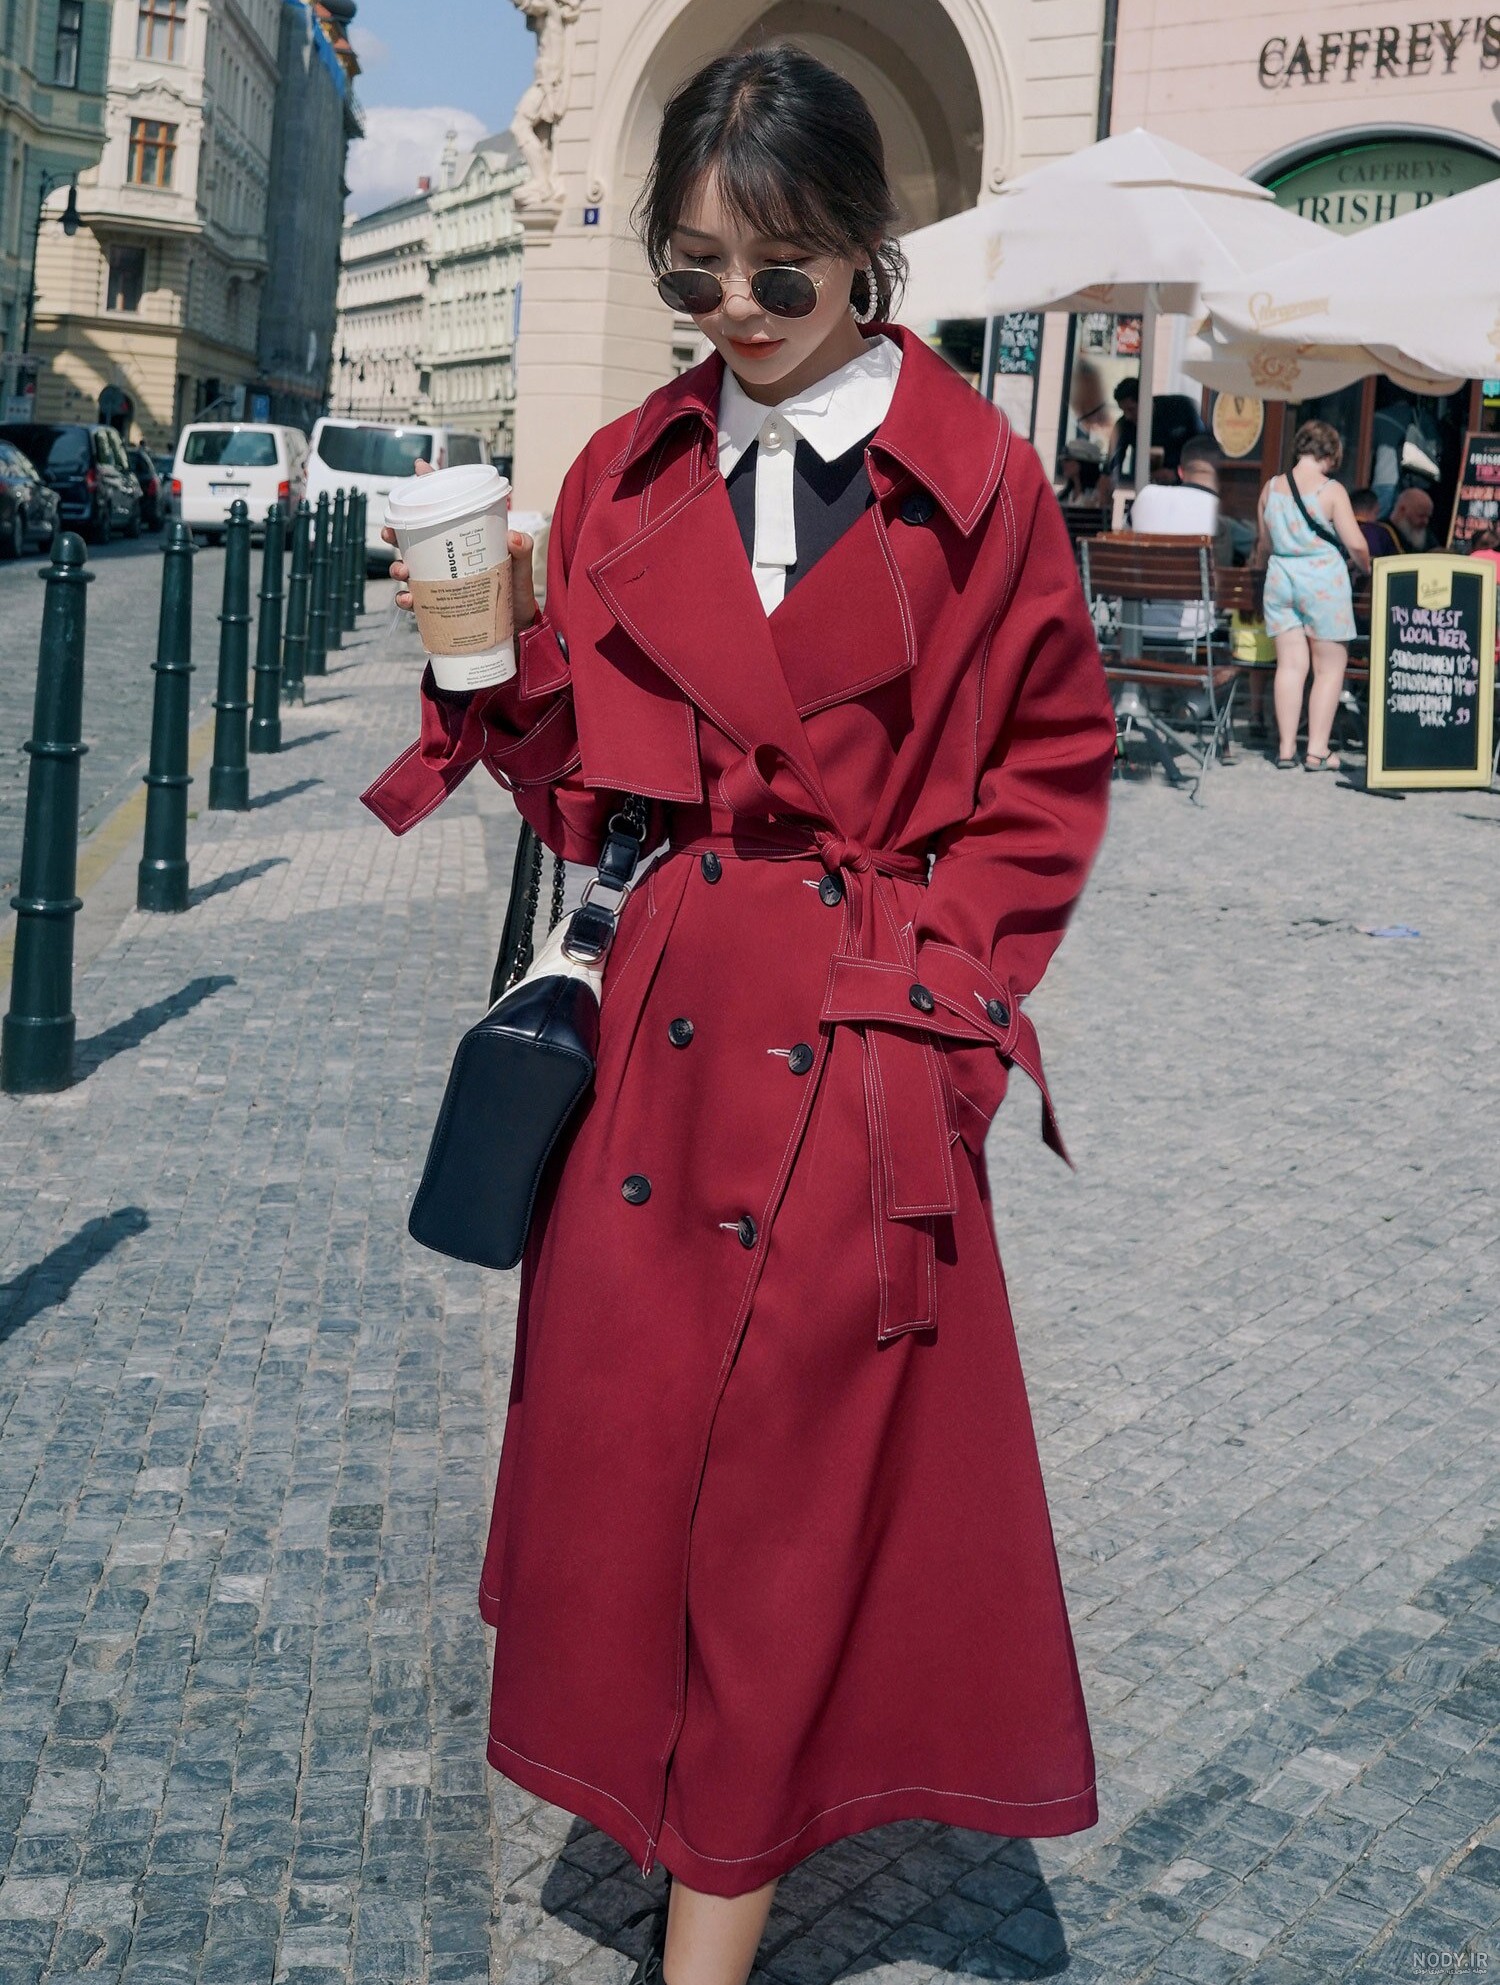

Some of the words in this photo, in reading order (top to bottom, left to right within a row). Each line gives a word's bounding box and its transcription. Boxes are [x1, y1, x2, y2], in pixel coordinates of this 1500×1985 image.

[1258, 13, 1500, 80] CAFFREY'S
[1297, 193, 1397, 224] IRISH
[1391, 606, 1409, 626] TRY
[1431, 609, 1463, 628] BEST
[1400, 626, 1437, 646] LOCAL
[1438, 628, 1471, 653] BEER
